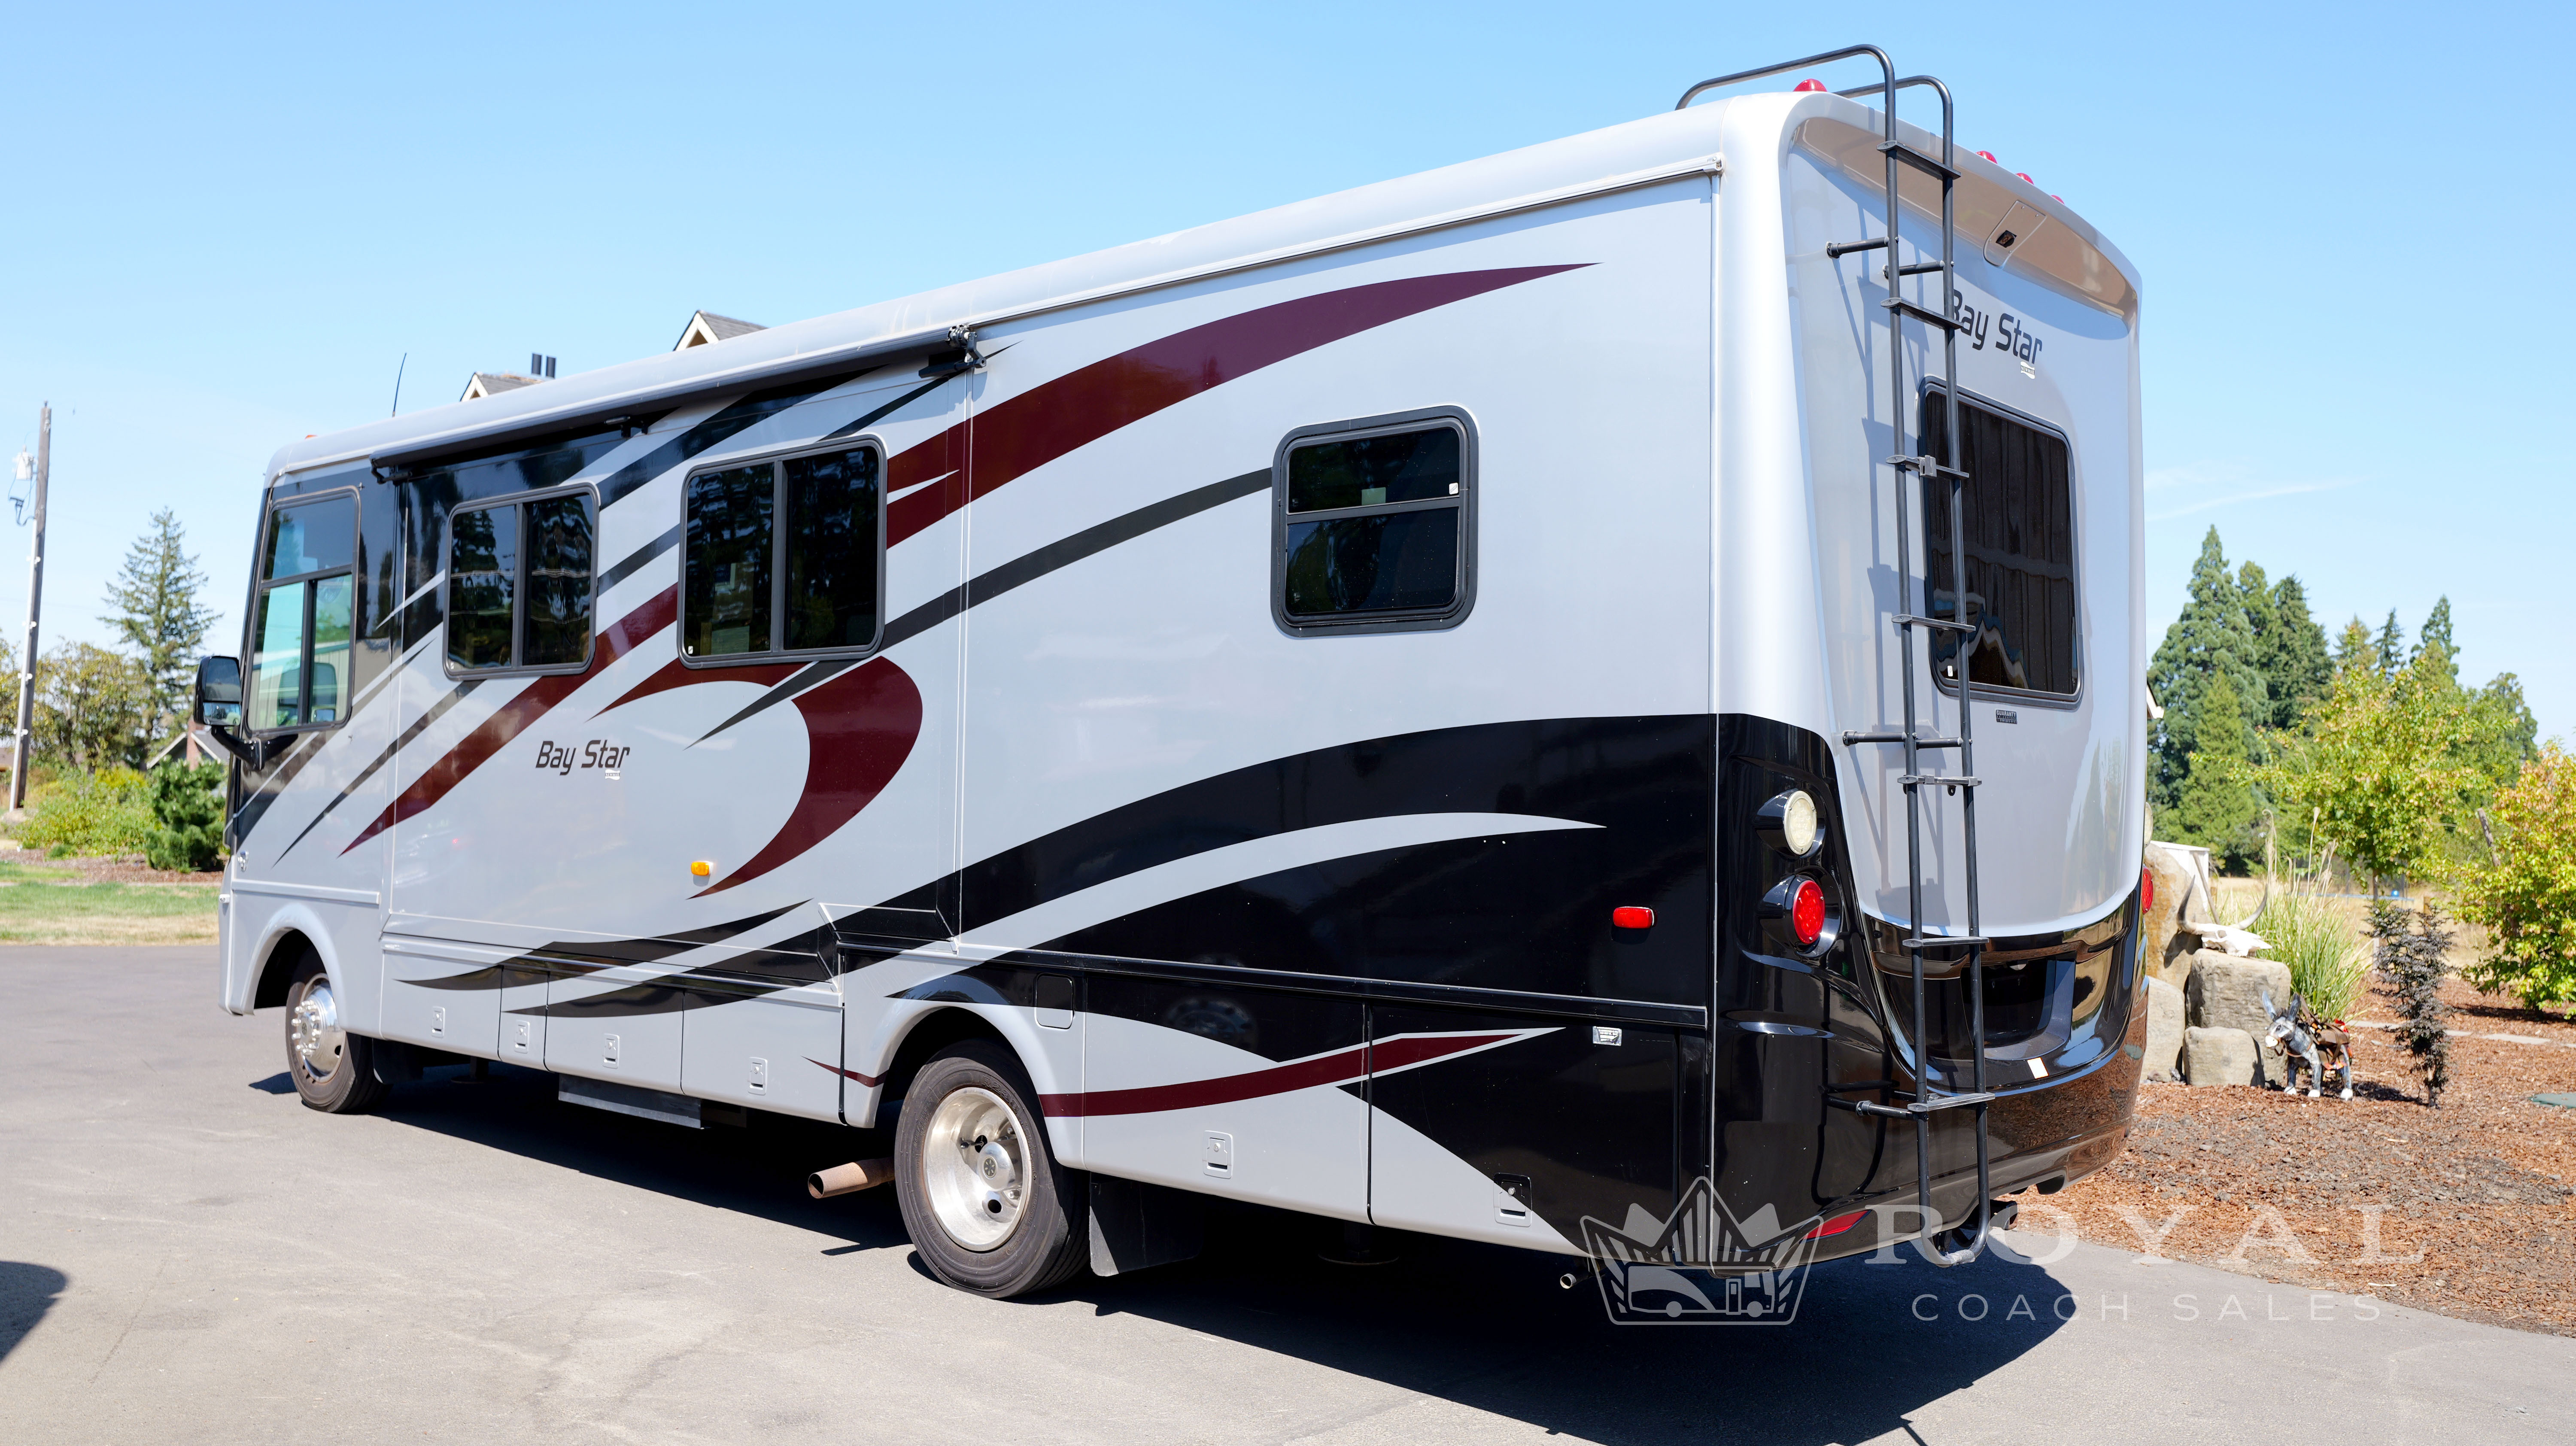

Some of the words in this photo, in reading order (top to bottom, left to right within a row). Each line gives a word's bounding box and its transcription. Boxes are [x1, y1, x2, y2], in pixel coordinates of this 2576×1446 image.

[1996, 313, 2042, 364] Star
[535, 741, 577, 775] Bay
[581, 739, 630, 768] Star
